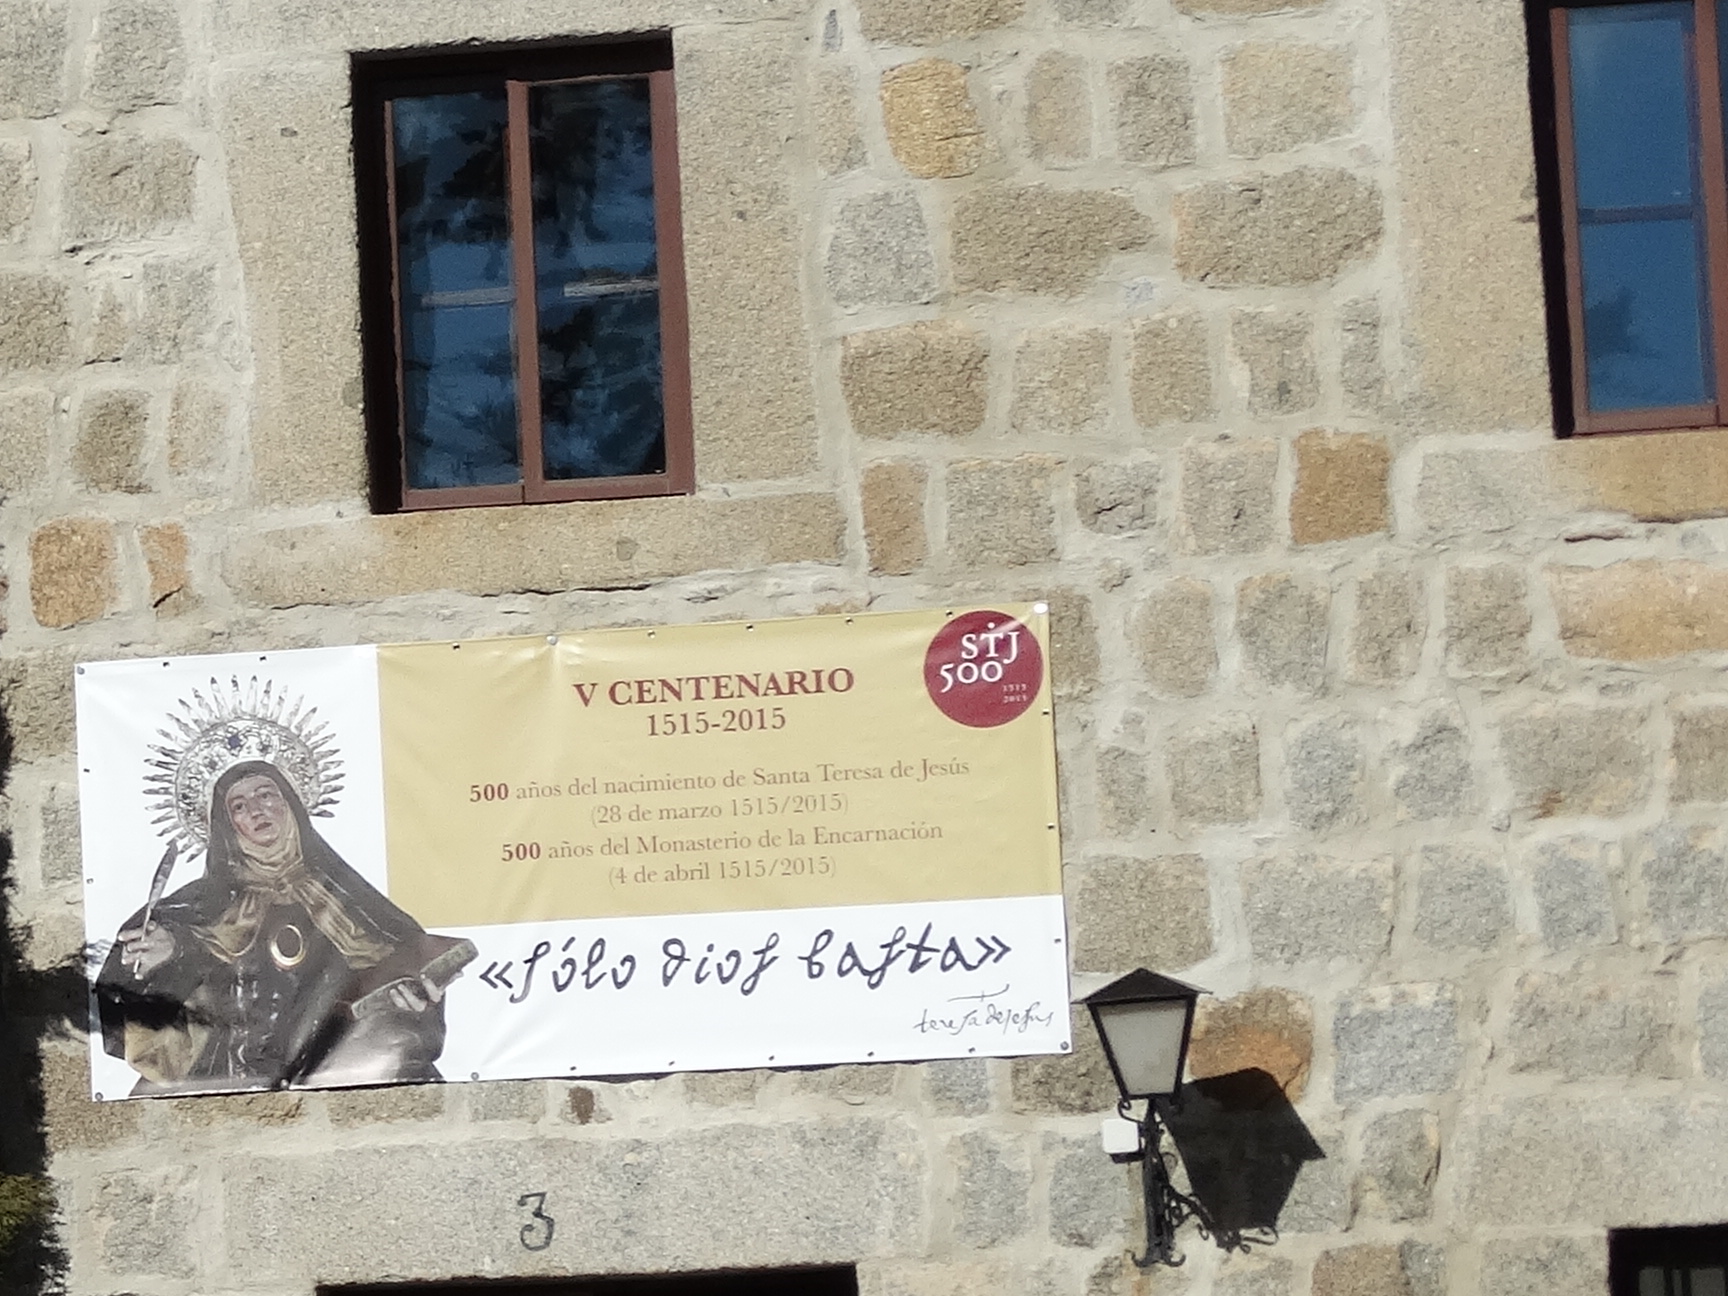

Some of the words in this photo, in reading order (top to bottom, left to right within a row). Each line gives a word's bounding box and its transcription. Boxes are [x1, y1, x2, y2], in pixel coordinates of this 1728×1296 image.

[571, 682, 598, 708] V
[607, 667, 856, 706] CENTENARIO
[939, 660, 1003, 694] 500
[646, 706, 787, 737] 1515-2015
[469, 782, 510, 803] 500
[515, 780, 563, 801] años
[567, 776, 598, 798] del
[603, 771, 717, 795] nacimiento
[722, 769, 747, 790] de
[752, 767, 811, 787] Santa
[816, 763, 884, 783] Teresa
[890, 759, 914, 779] de
[917, 757, 970, 783] Jesús
[590, 805, 623, 829] (28
[627, 803, 654, 823] de
[657, 804, 723, 822] marzo
[730, 792, 849, 818] 1515/2015)
[500, 840, 542, 863] 500
[547, 839, 594, 860] años
[599, 835, 631, 857] del
[635, 832, 752, 855] Monasterio
[757, 829, 782, 849] de
[788, 828, 806, 847] la
[813, 821, 944, 846] Encarnación
[607, 865, 628, 891] (4
[633, 863, 659, 884] de
[663, 859, 711, 884] abril
[718, 855, 837, 881] 1515/2015)
[517, 1191, 555, 1252] 3
